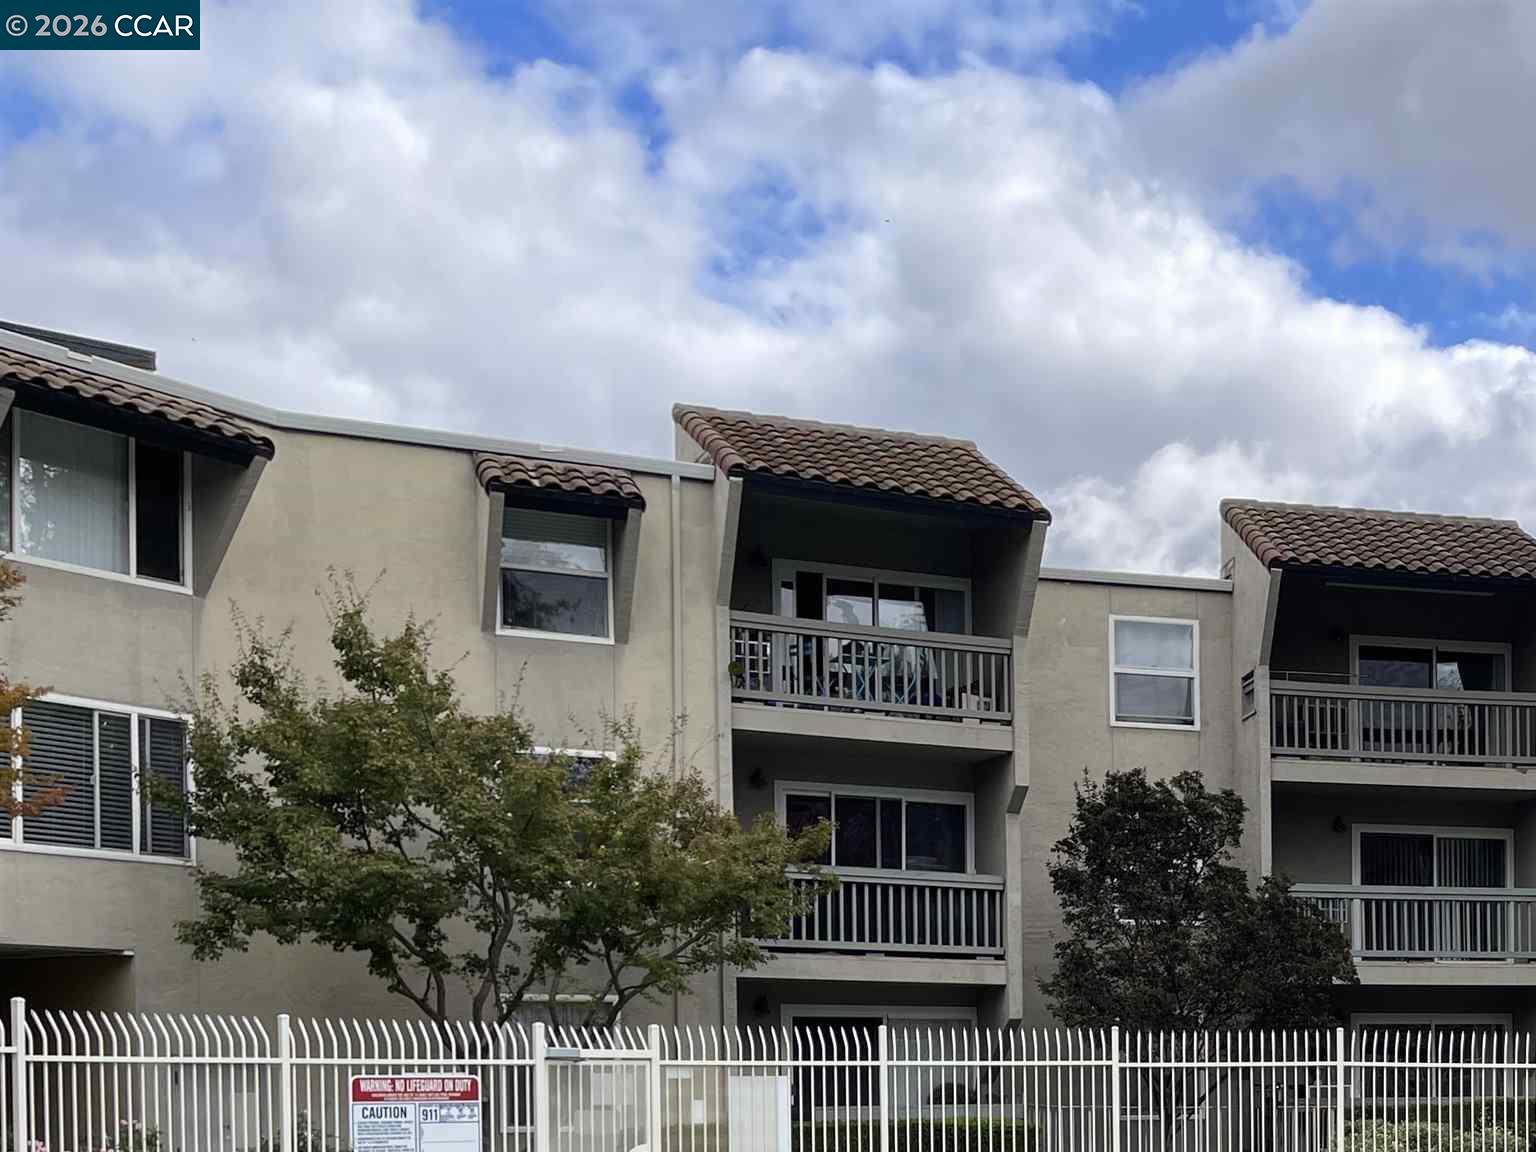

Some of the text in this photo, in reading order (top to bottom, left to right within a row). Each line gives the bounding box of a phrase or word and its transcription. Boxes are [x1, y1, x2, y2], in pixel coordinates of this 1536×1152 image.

[395, 1079, 405, 1092] NO
[406, 1079, 443, 1092] LIFEGUARD
[444, 1079, 454, 1092] ON
[455, 1079, 472, 1092] DUTY
[361, 1106, 407, 1119] CAUTION
[421, 1109, 438, 1121] 911
